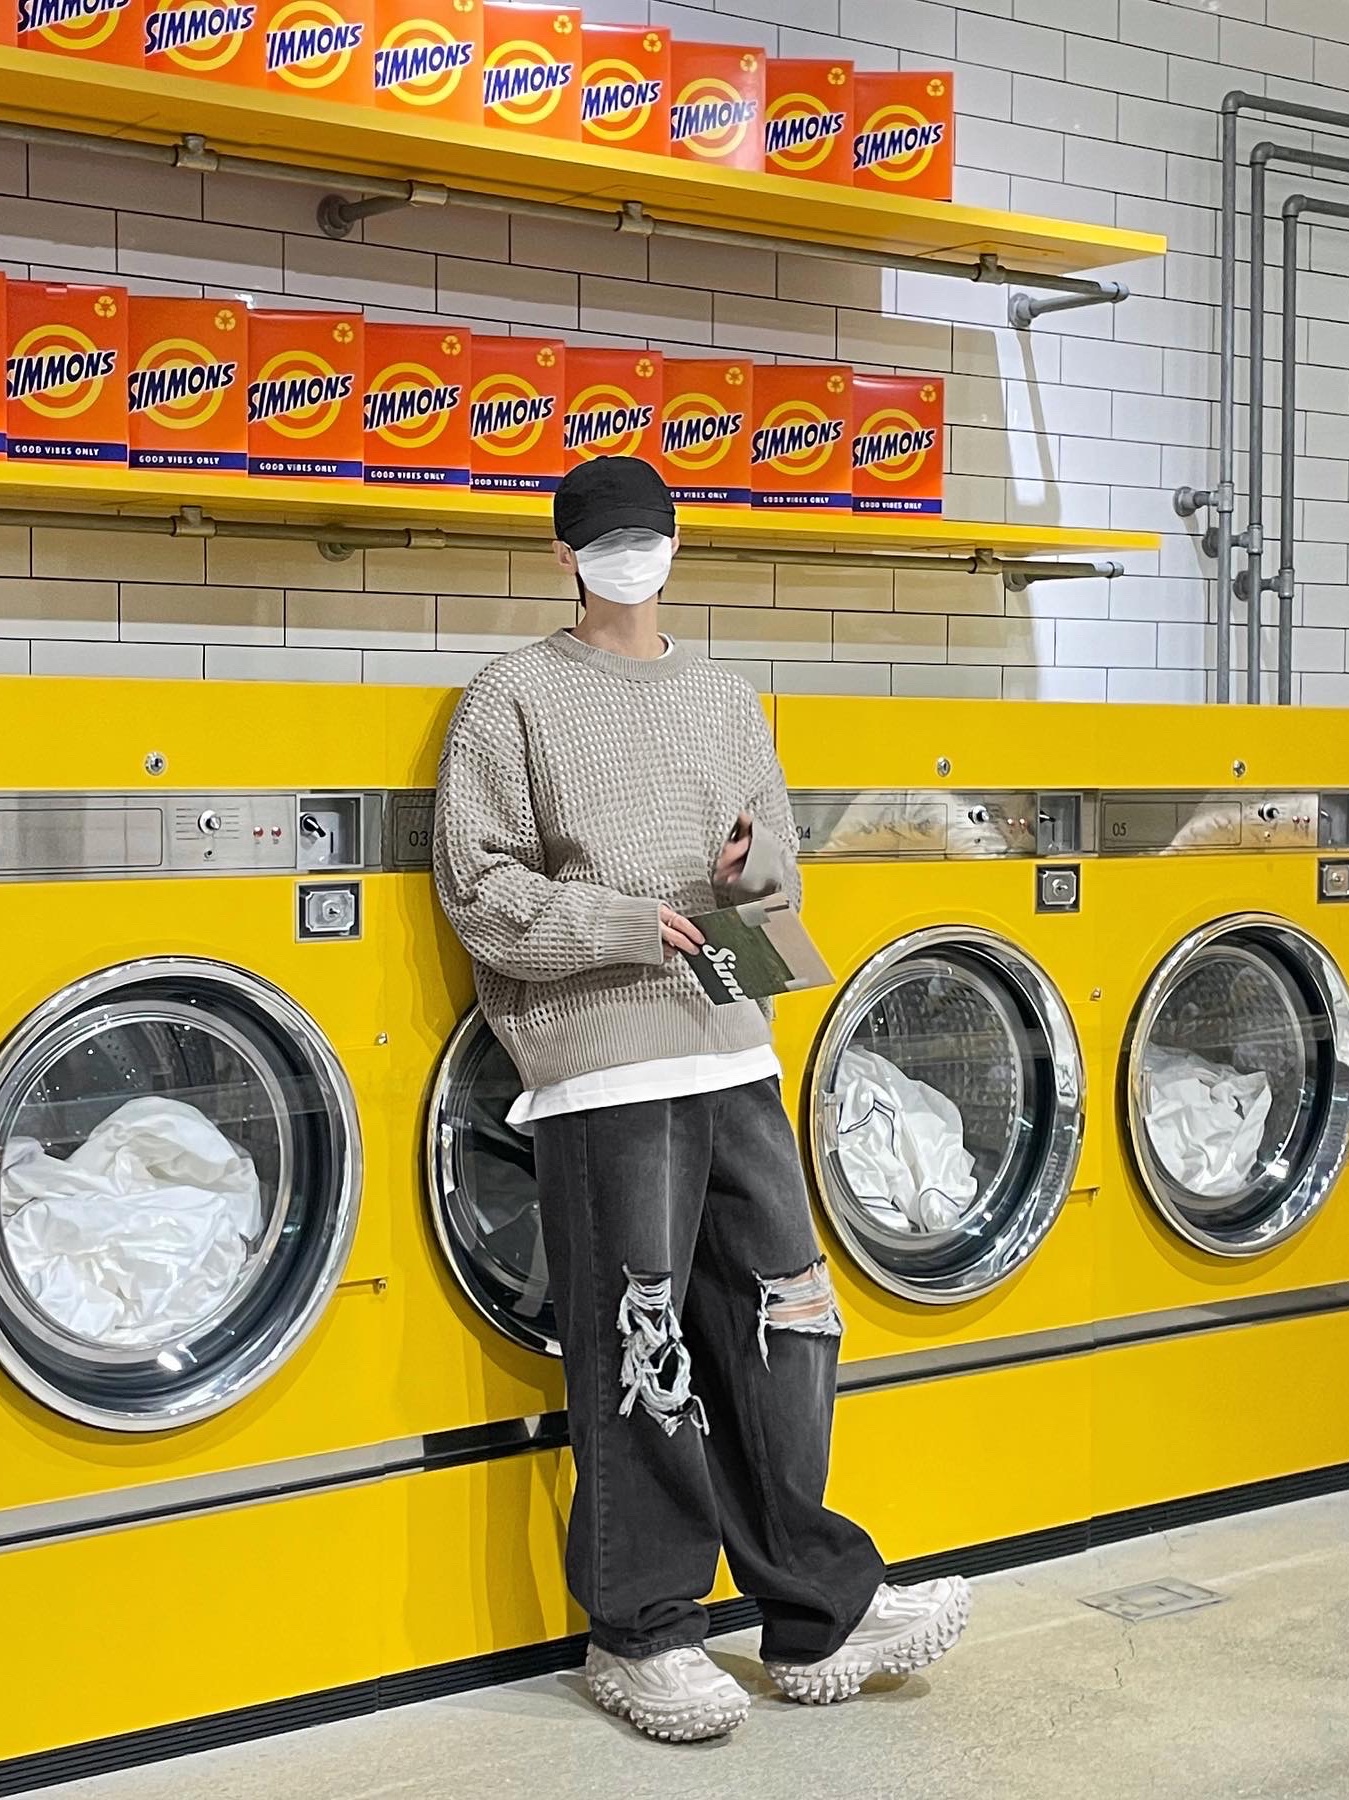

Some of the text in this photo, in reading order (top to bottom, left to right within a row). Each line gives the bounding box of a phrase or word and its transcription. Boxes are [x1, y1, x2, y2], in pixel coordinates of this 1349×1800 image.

[145, 7, 255, 54] SIMMONS
[267, 25, 363, 69] IMMONS
[484, 64, 572, 105] IMMONS
[766, 113, 843, 153] IMMONS
[853, 124, 943, 169] SIMMONS
[128, 364, 235, 411] SIMMONS
[248, 376, 353, 422] SIMMONS
[471, 398, 554, 437] IMMONS
[662, 415, 743, 453] IMMONS
[15, 443, 99, 455] GOOD VIBES ONLY
[139, 455, 220, 466] GOOD VIBES ONLY
[751, 421, 843, 464] SIMMONS
[259, 462, 337, 473] GOOD VIBES ONLY
[371, 470, 445, 481] GOOD VIBES ONLY
[408, 830, 429, 847] 03
[1112, 822, 1127, 837] 05
